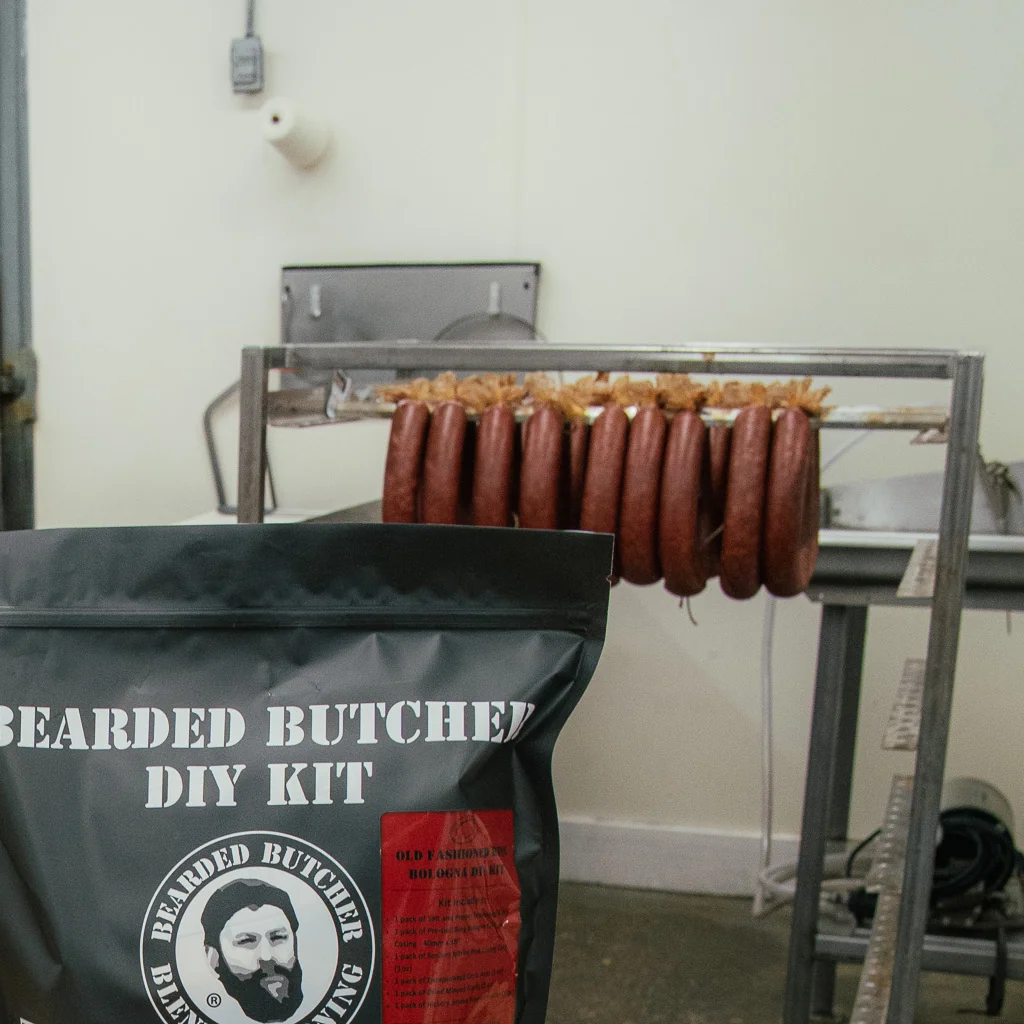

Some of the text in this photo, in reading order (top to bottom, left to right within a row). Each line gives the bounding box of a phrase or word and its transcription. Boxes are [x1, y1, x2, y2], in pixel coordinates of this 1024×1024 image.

[145, 761, 373, 808] DIY KIT
[395, 850, 423, 861] OLD
[409, 866, 468, 880] BOLOGNA
[151, 842, 363, 943] BEARDED BUTCHER
